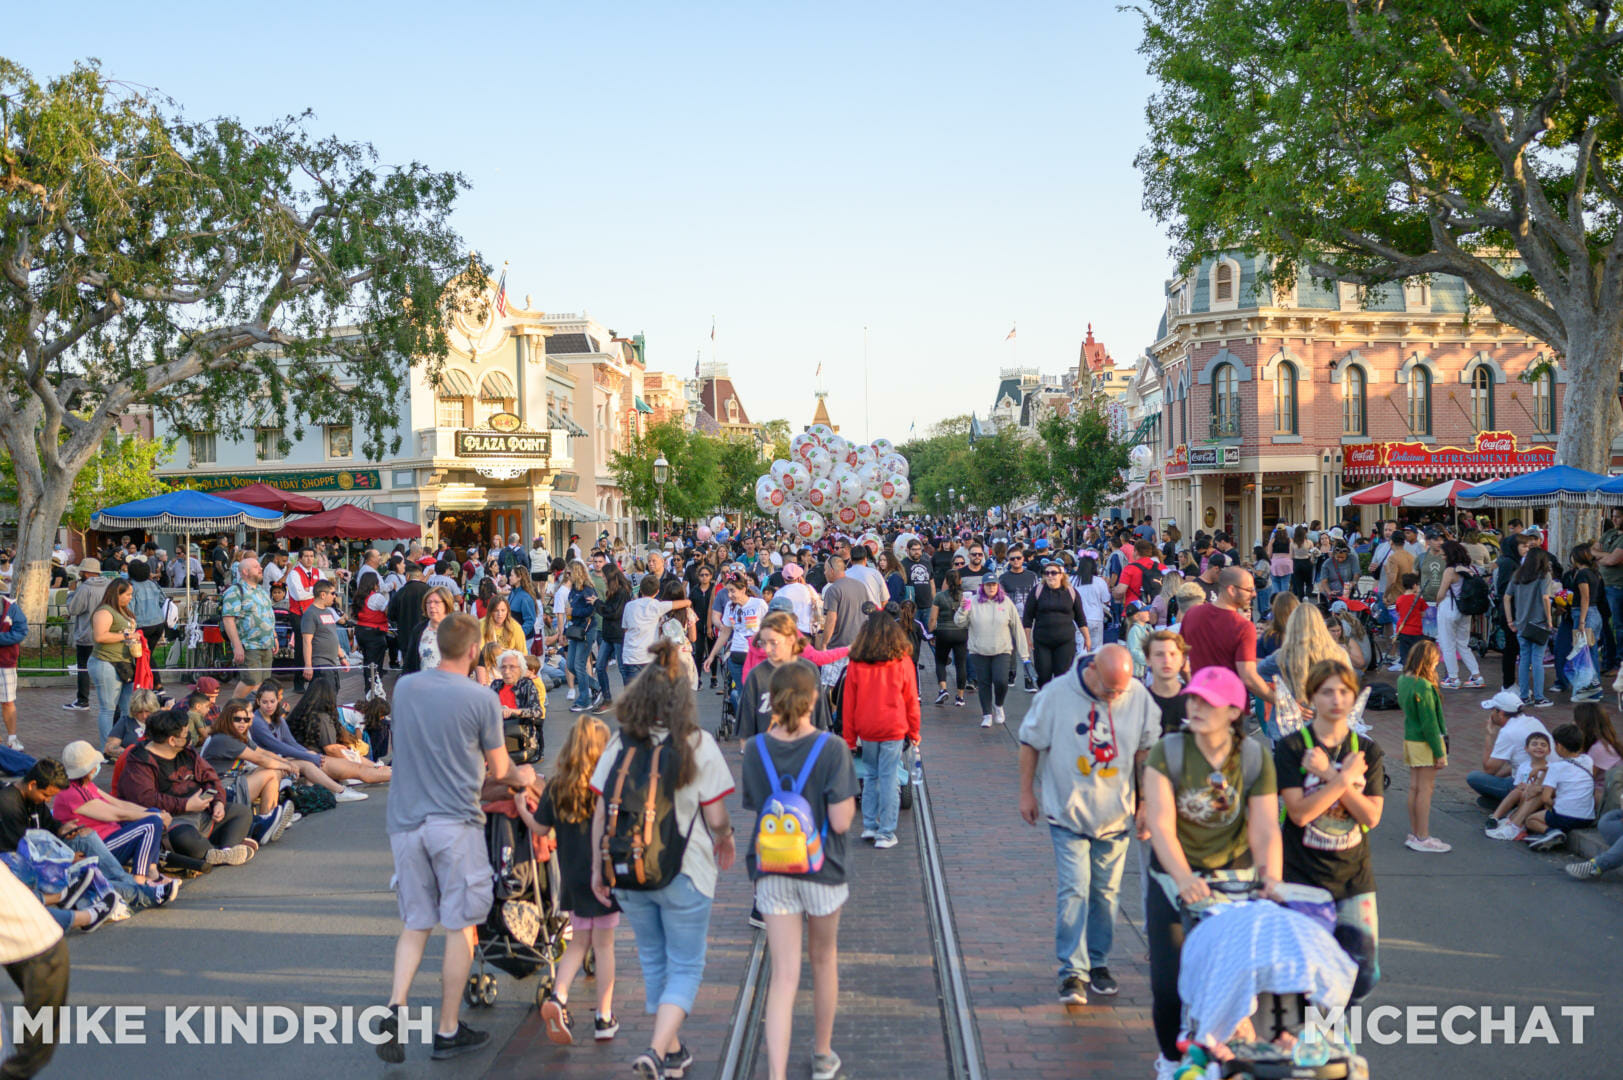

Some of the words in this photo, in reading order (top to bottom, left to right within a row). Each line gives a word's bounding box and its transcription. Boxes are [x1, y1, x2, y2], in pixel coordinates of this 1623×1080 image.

[464, 436, 506, 451] PLAZA
[507, 436, 547, 452] POINT
[1480, 439, 1511, 451] Coca-Cola
[1191, 452, 1216, 462] Coca-Cola
[1351, 449, 1375, 462] Coca-Cola
[1390, 450, 1425, 462] Delicious
[1431, 454, 1509, 463] REFRESHMENT
[202, 478, 230, 490] PLAZA
[301, 475, 335, 489] SHOPPE
[729, 607, 757, 616] MKEY
